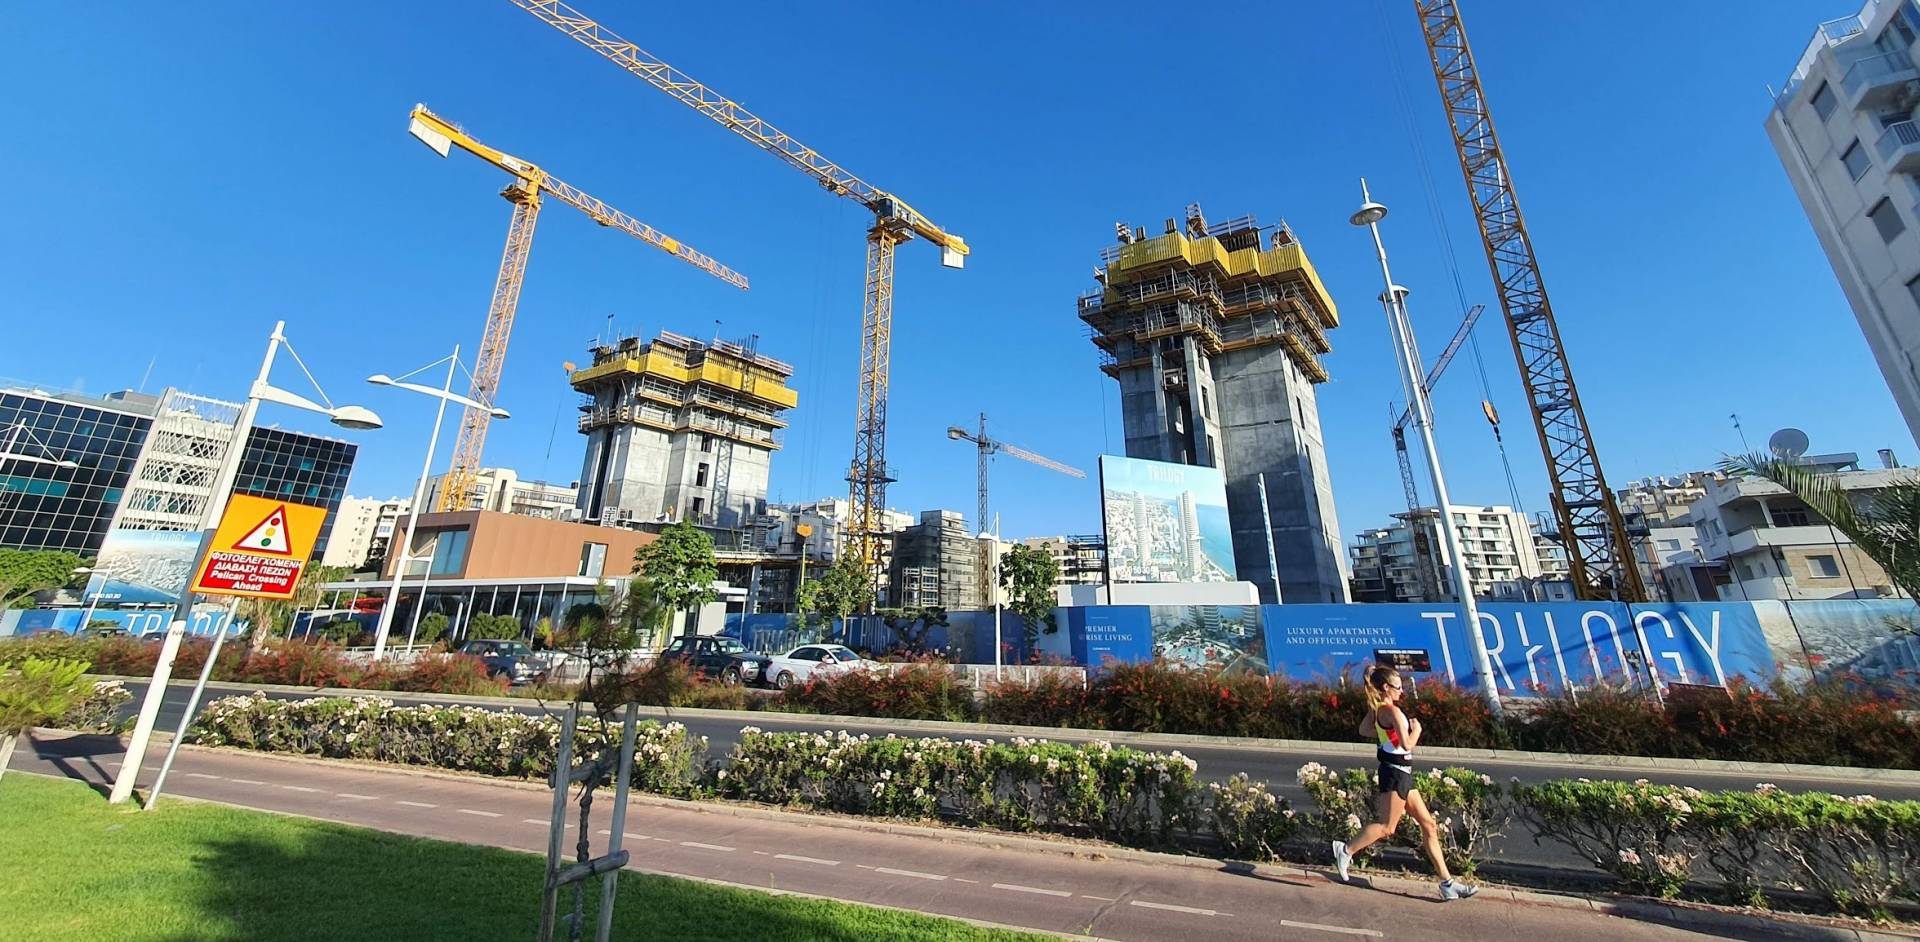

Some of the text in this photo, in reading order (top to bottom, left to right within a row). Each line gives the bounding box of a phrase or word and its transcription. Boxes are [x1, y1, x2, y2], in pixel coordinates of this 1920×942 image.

[214, 562, 292, 576] ΔΙΑΒΑΣΗ ΠΕΖΩΝ
[210, 570, 288, 586] Pelican Crossing
[232, 581, 263, 591] Ahead
[1287, 627, 1392, 635] LUXURY APARTMENTS
[1286, 637, 1306, 645] AND
[1308, 637, 1348, 645] OFFICES
[1371, 638, 1396, 646] SALE
[1421, 610, 1733, 698] TRILOGY
